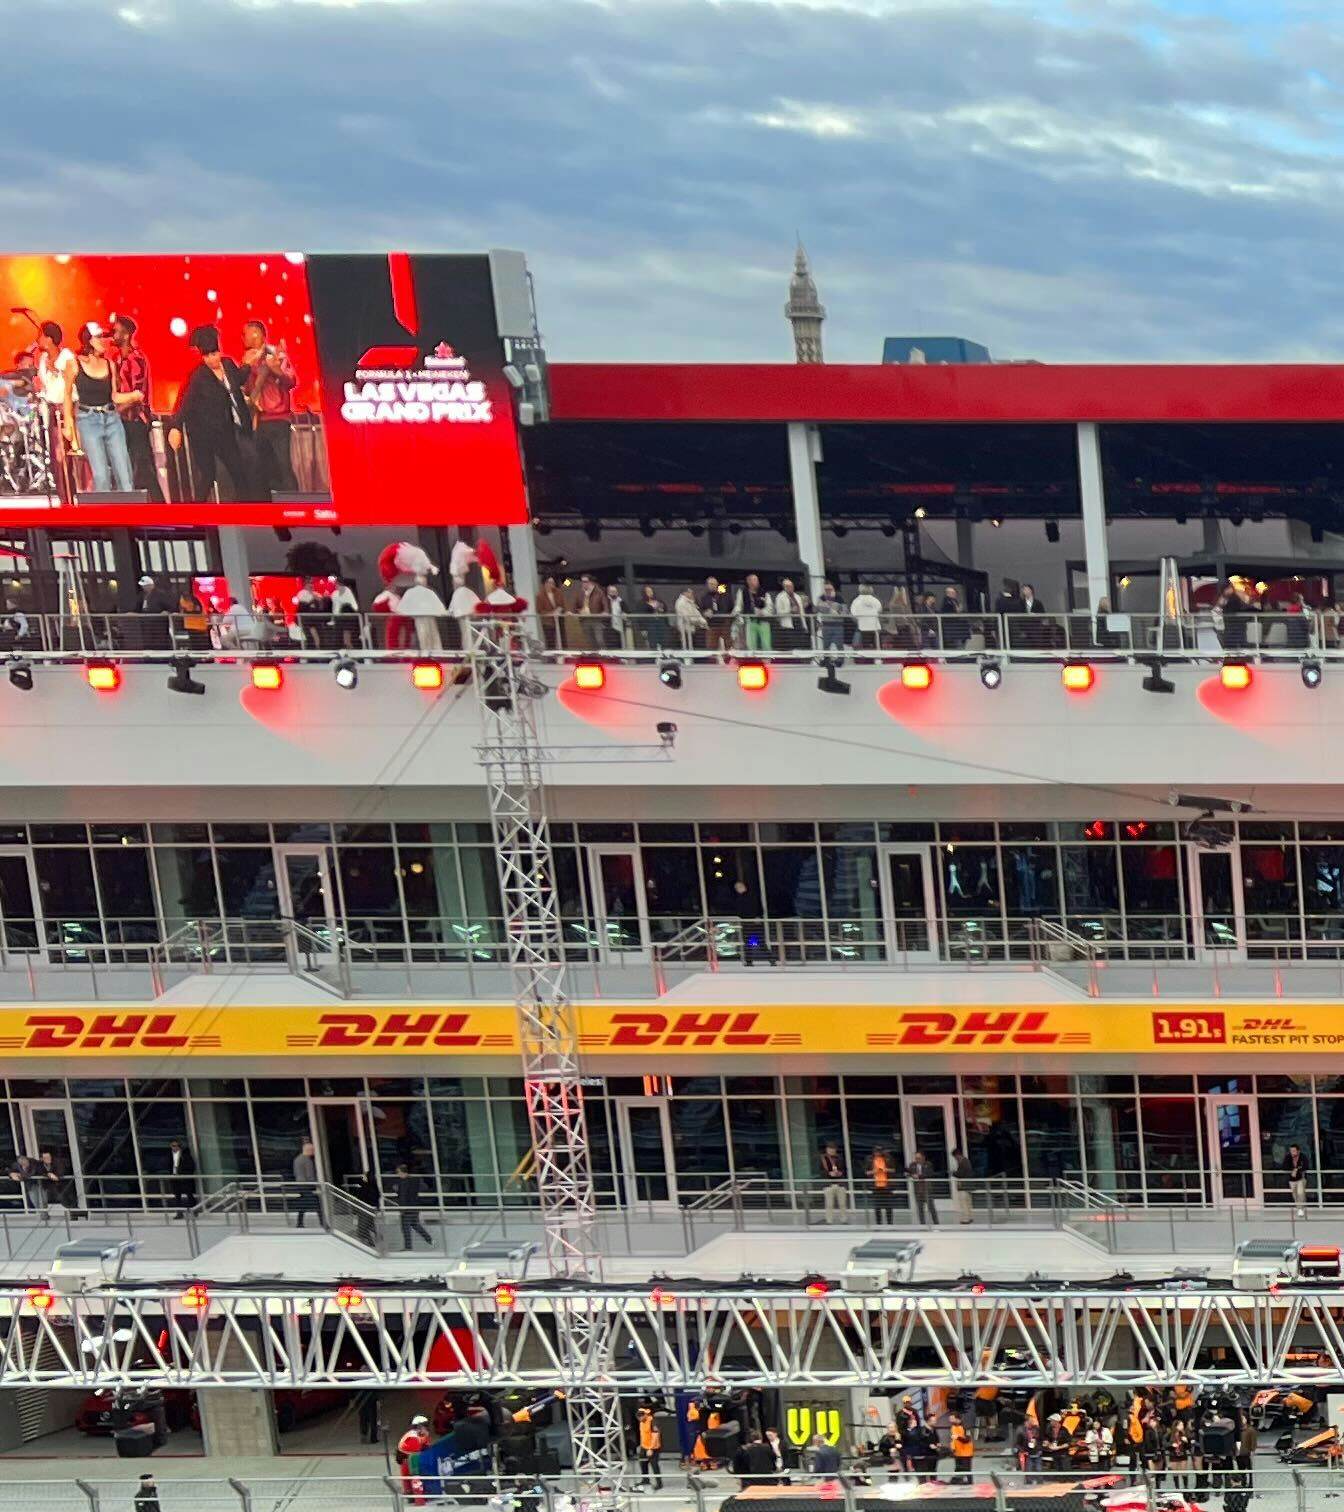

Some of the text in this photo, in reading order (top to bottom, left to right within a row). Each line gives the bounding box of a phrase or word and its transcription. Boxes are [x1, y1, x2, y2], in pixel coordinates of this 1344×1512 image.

[344, 382, 486, 401] LAS VEGAS
[341, 402, 493, 423] GRAND PRIX
[26, 1015, 191, 1048] DHL
[319, 1015, 483, 1046] DHL
[610, 1014, 770, 1045] DHL
[899, 1013, 1062, 1044] DHL
[1243, 1019, 1296, 1030] DHL
[1232, 1035, 1285, 1044] FASTEST
[1289, 1035, 1309, 1044] PIT
[1313, 1035, 1344, 1044] STOP
